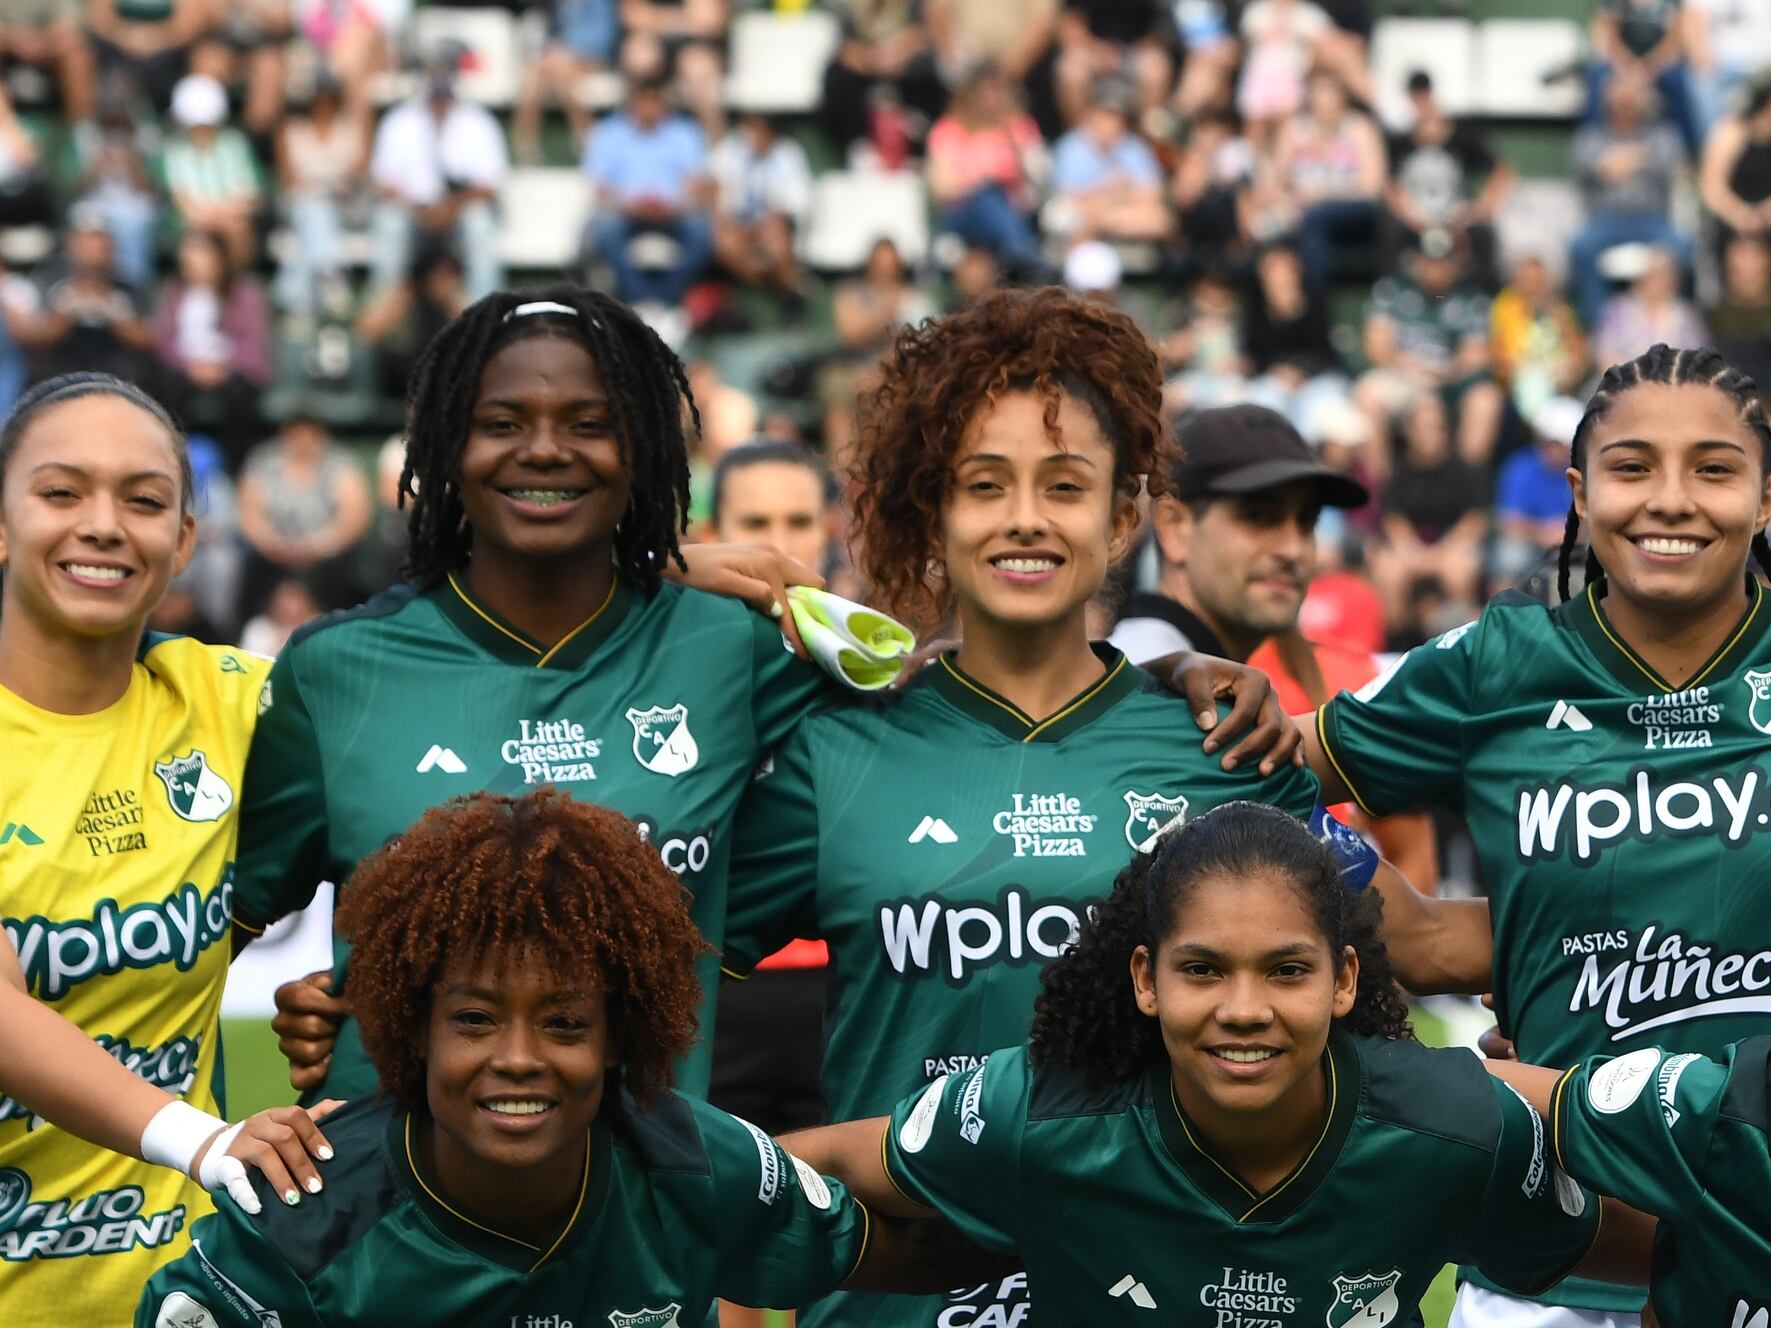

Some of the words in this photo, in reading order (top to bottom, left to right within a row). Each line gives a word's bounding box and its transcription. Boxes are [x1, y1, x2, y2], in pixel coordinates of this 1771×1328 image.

[635, 713, 682, 725] DEPORTIVO
[1626, 702, 1720, 726] Caesars
[519, 718, 585, 745] Little
[638, 723, 689, 764] CALI
[1644, 725, 1713, 750] Pizza
[501, 737, 603, 764] Caesars
[523, 762, 597, 784] Pizza
[168, 776, 226, 804] CALI
[1012, 792, 1081, 816] Little
[1133, 800, 1182, 812] DEPORTIVO
[992, 811, 1094, 835] Caesars
[1134, 808, 1160, 831] CA
[86, 831, 148, 857] Pizza
[1012, 833, 1087, 858] Pizza
[1562, 929, 1629, 956] PASTAS
[1635, 925, 1682, 963] La
[0, 1208, 184, 1259] ARDENT
[1222, 1266, 1287, 1294] Little
[1341, 1277, 1393, 1292] DEPORTIVO
[1200, 1283, 1296, 1315] Caesars
[1340, 1290, 1386, 1325] CALI
[617, 1311, 674, 1327] DEPORTIVO
